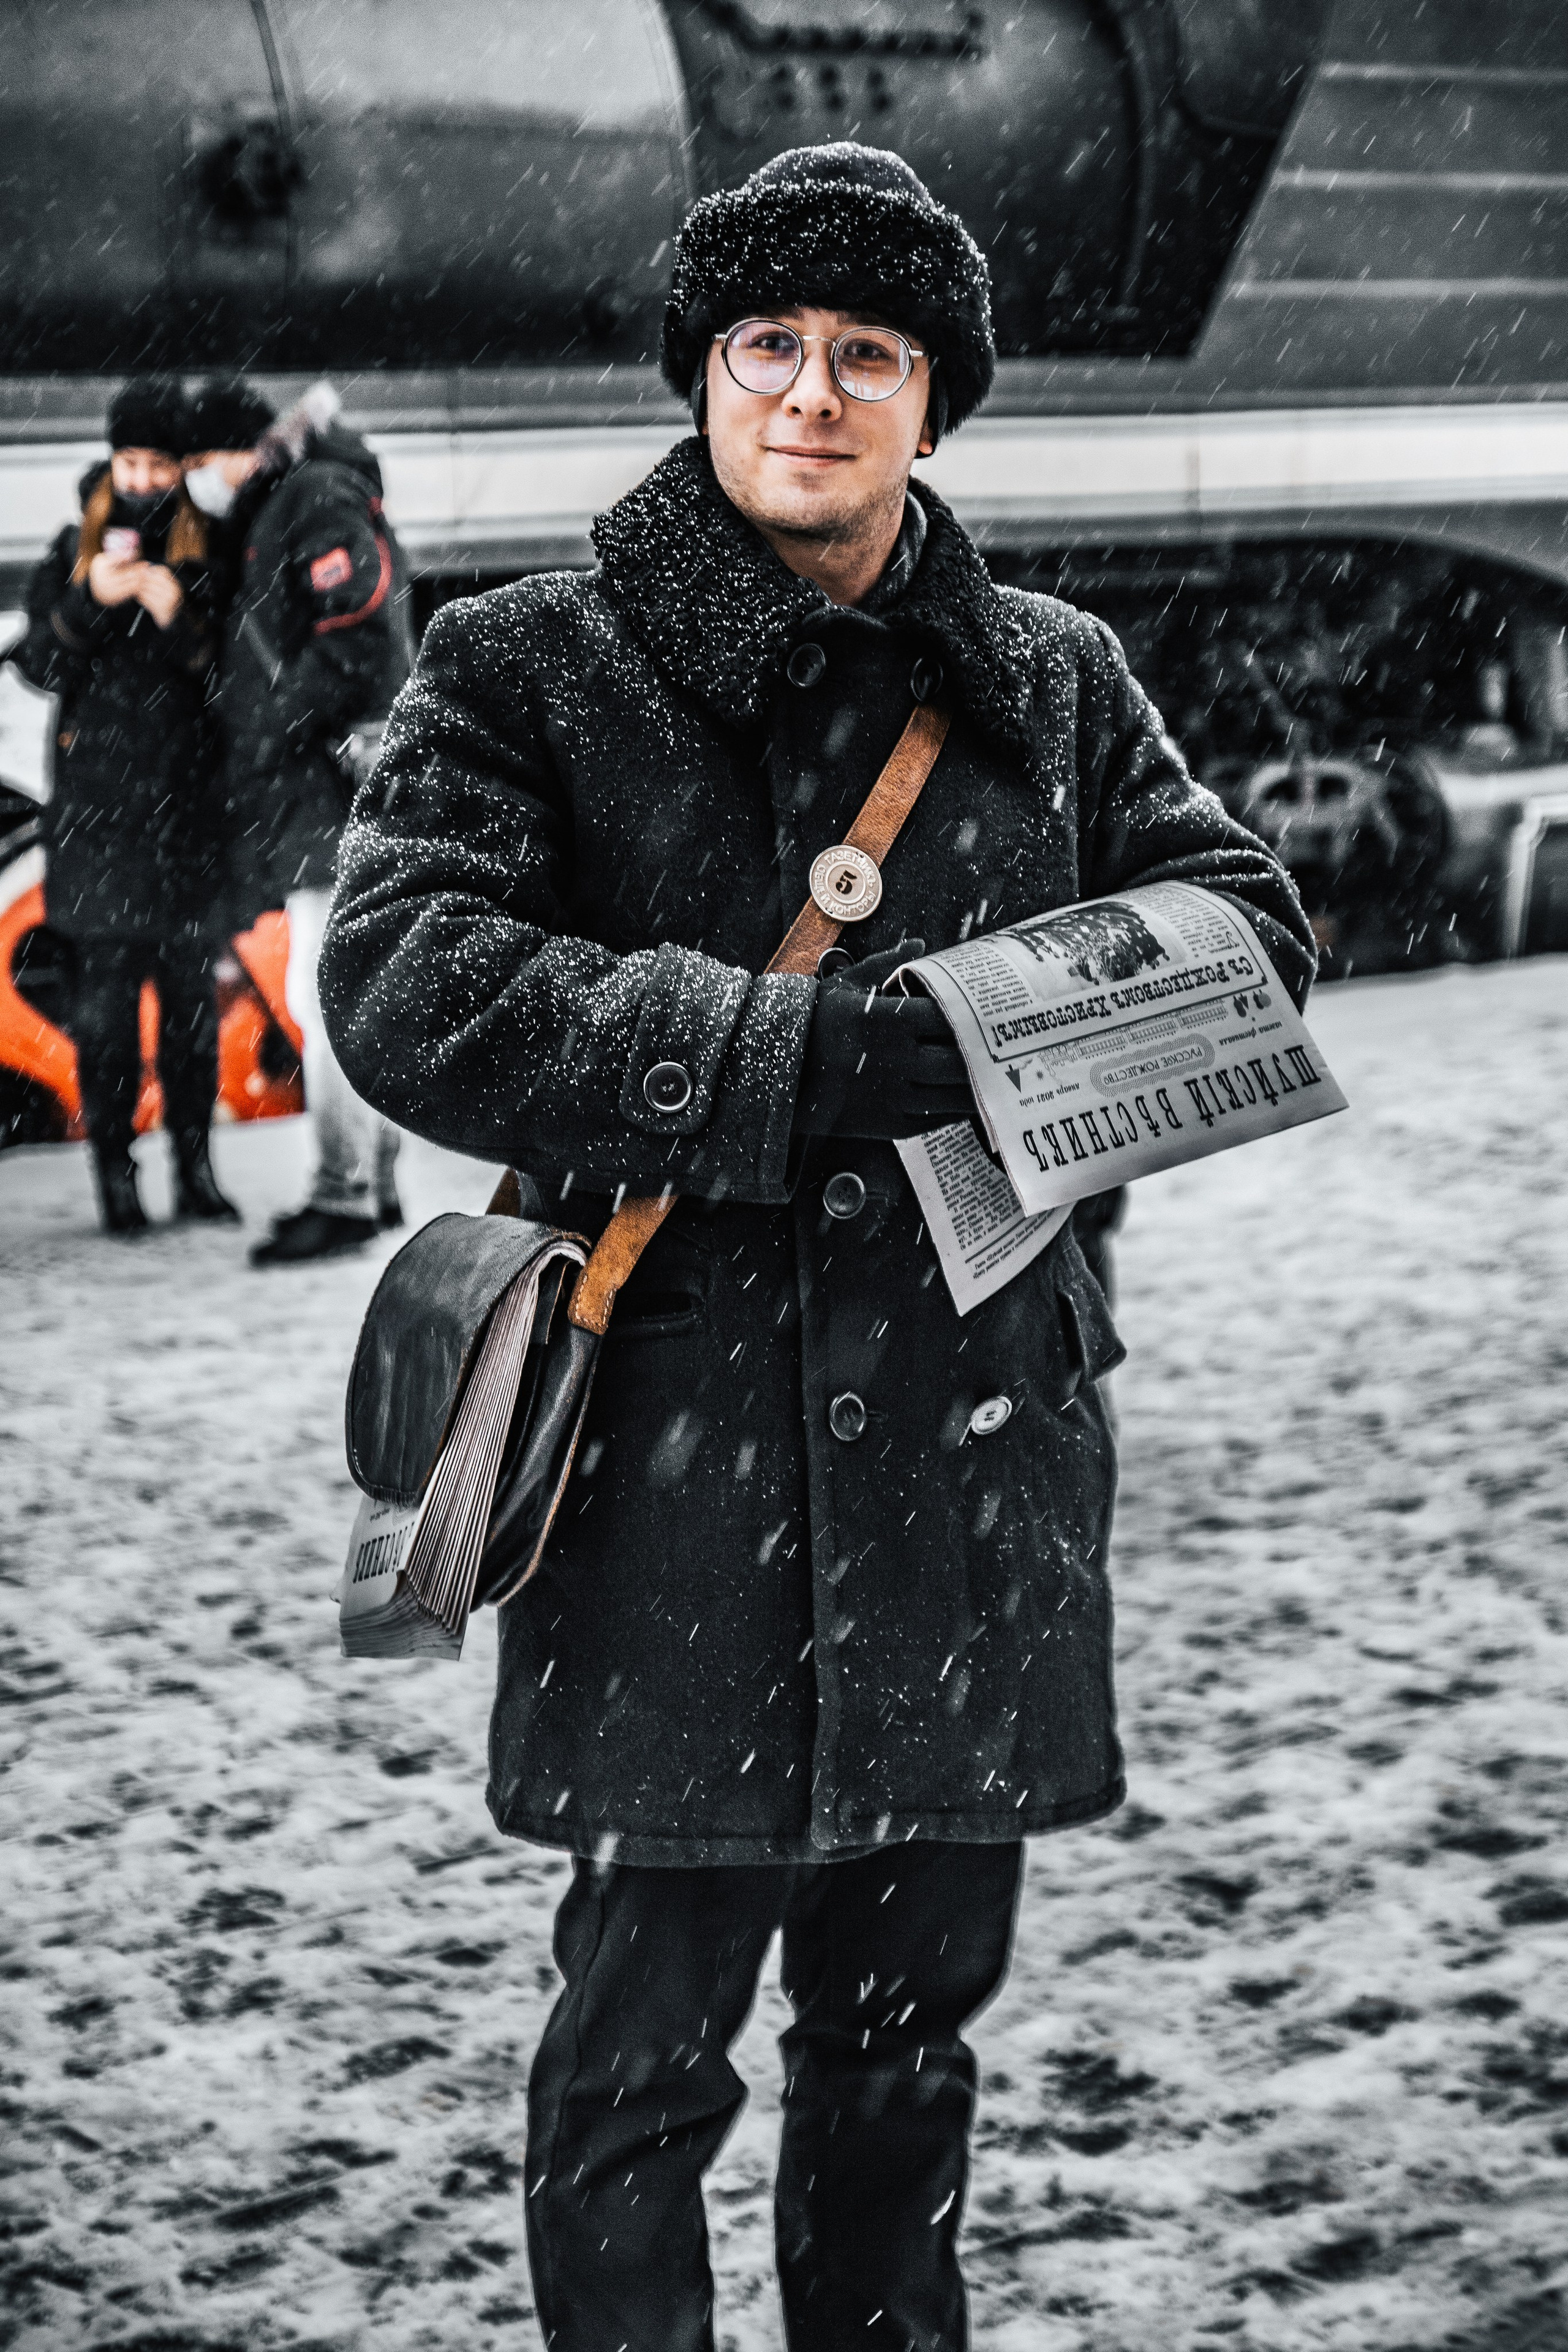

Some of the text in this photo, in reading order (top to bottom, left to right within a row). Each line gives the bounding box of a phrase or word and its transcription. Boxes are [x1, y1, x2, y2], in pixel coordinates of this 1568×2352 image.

[835, 870, 858, 895] 5
[829, 891, 876, 914] КОНТОРЫ
[1218, 1020, 1283, 1046] газета фестиваля
[1102, 1046, 1202, 1086] РУССКОЕ РОЖДЕСТВО
[1019, 1082, 1080, 1107] январь 2021 года
[1022, 1044, 1322, 1172] ШУЙСКІЙ ВѢСТНИКЪ
